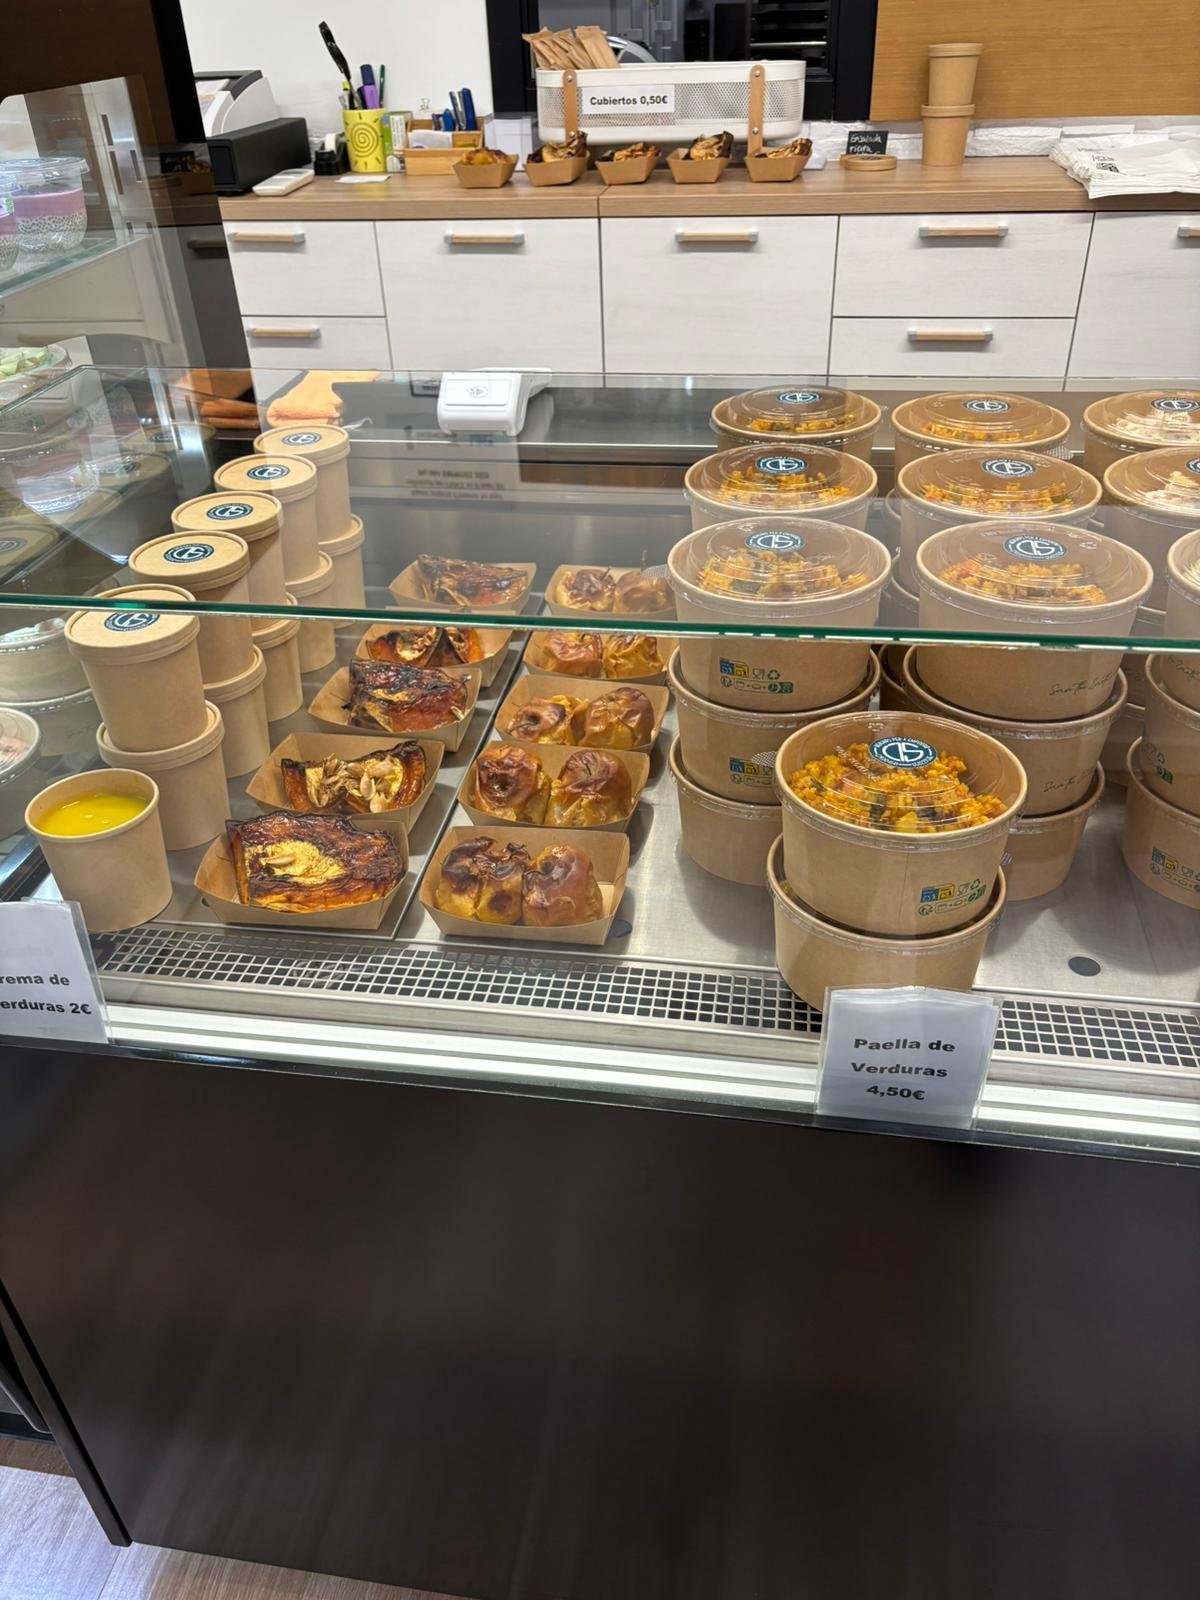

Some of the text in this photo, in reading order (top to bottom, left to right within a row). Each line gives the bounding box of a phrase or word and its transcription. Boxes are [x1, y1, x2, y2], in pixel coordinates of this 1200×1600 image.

[590, 95, 668, 106] Cubiertos 0,50€
[48, 973, 71, 986] de
[0, 998, 92, 1015] erduras 2€
[853, 1038, 956, 1052] Paella de
[850, 1061, 949, 1078] Verduras
[865, 1084, 926, 1101] 4,50€
